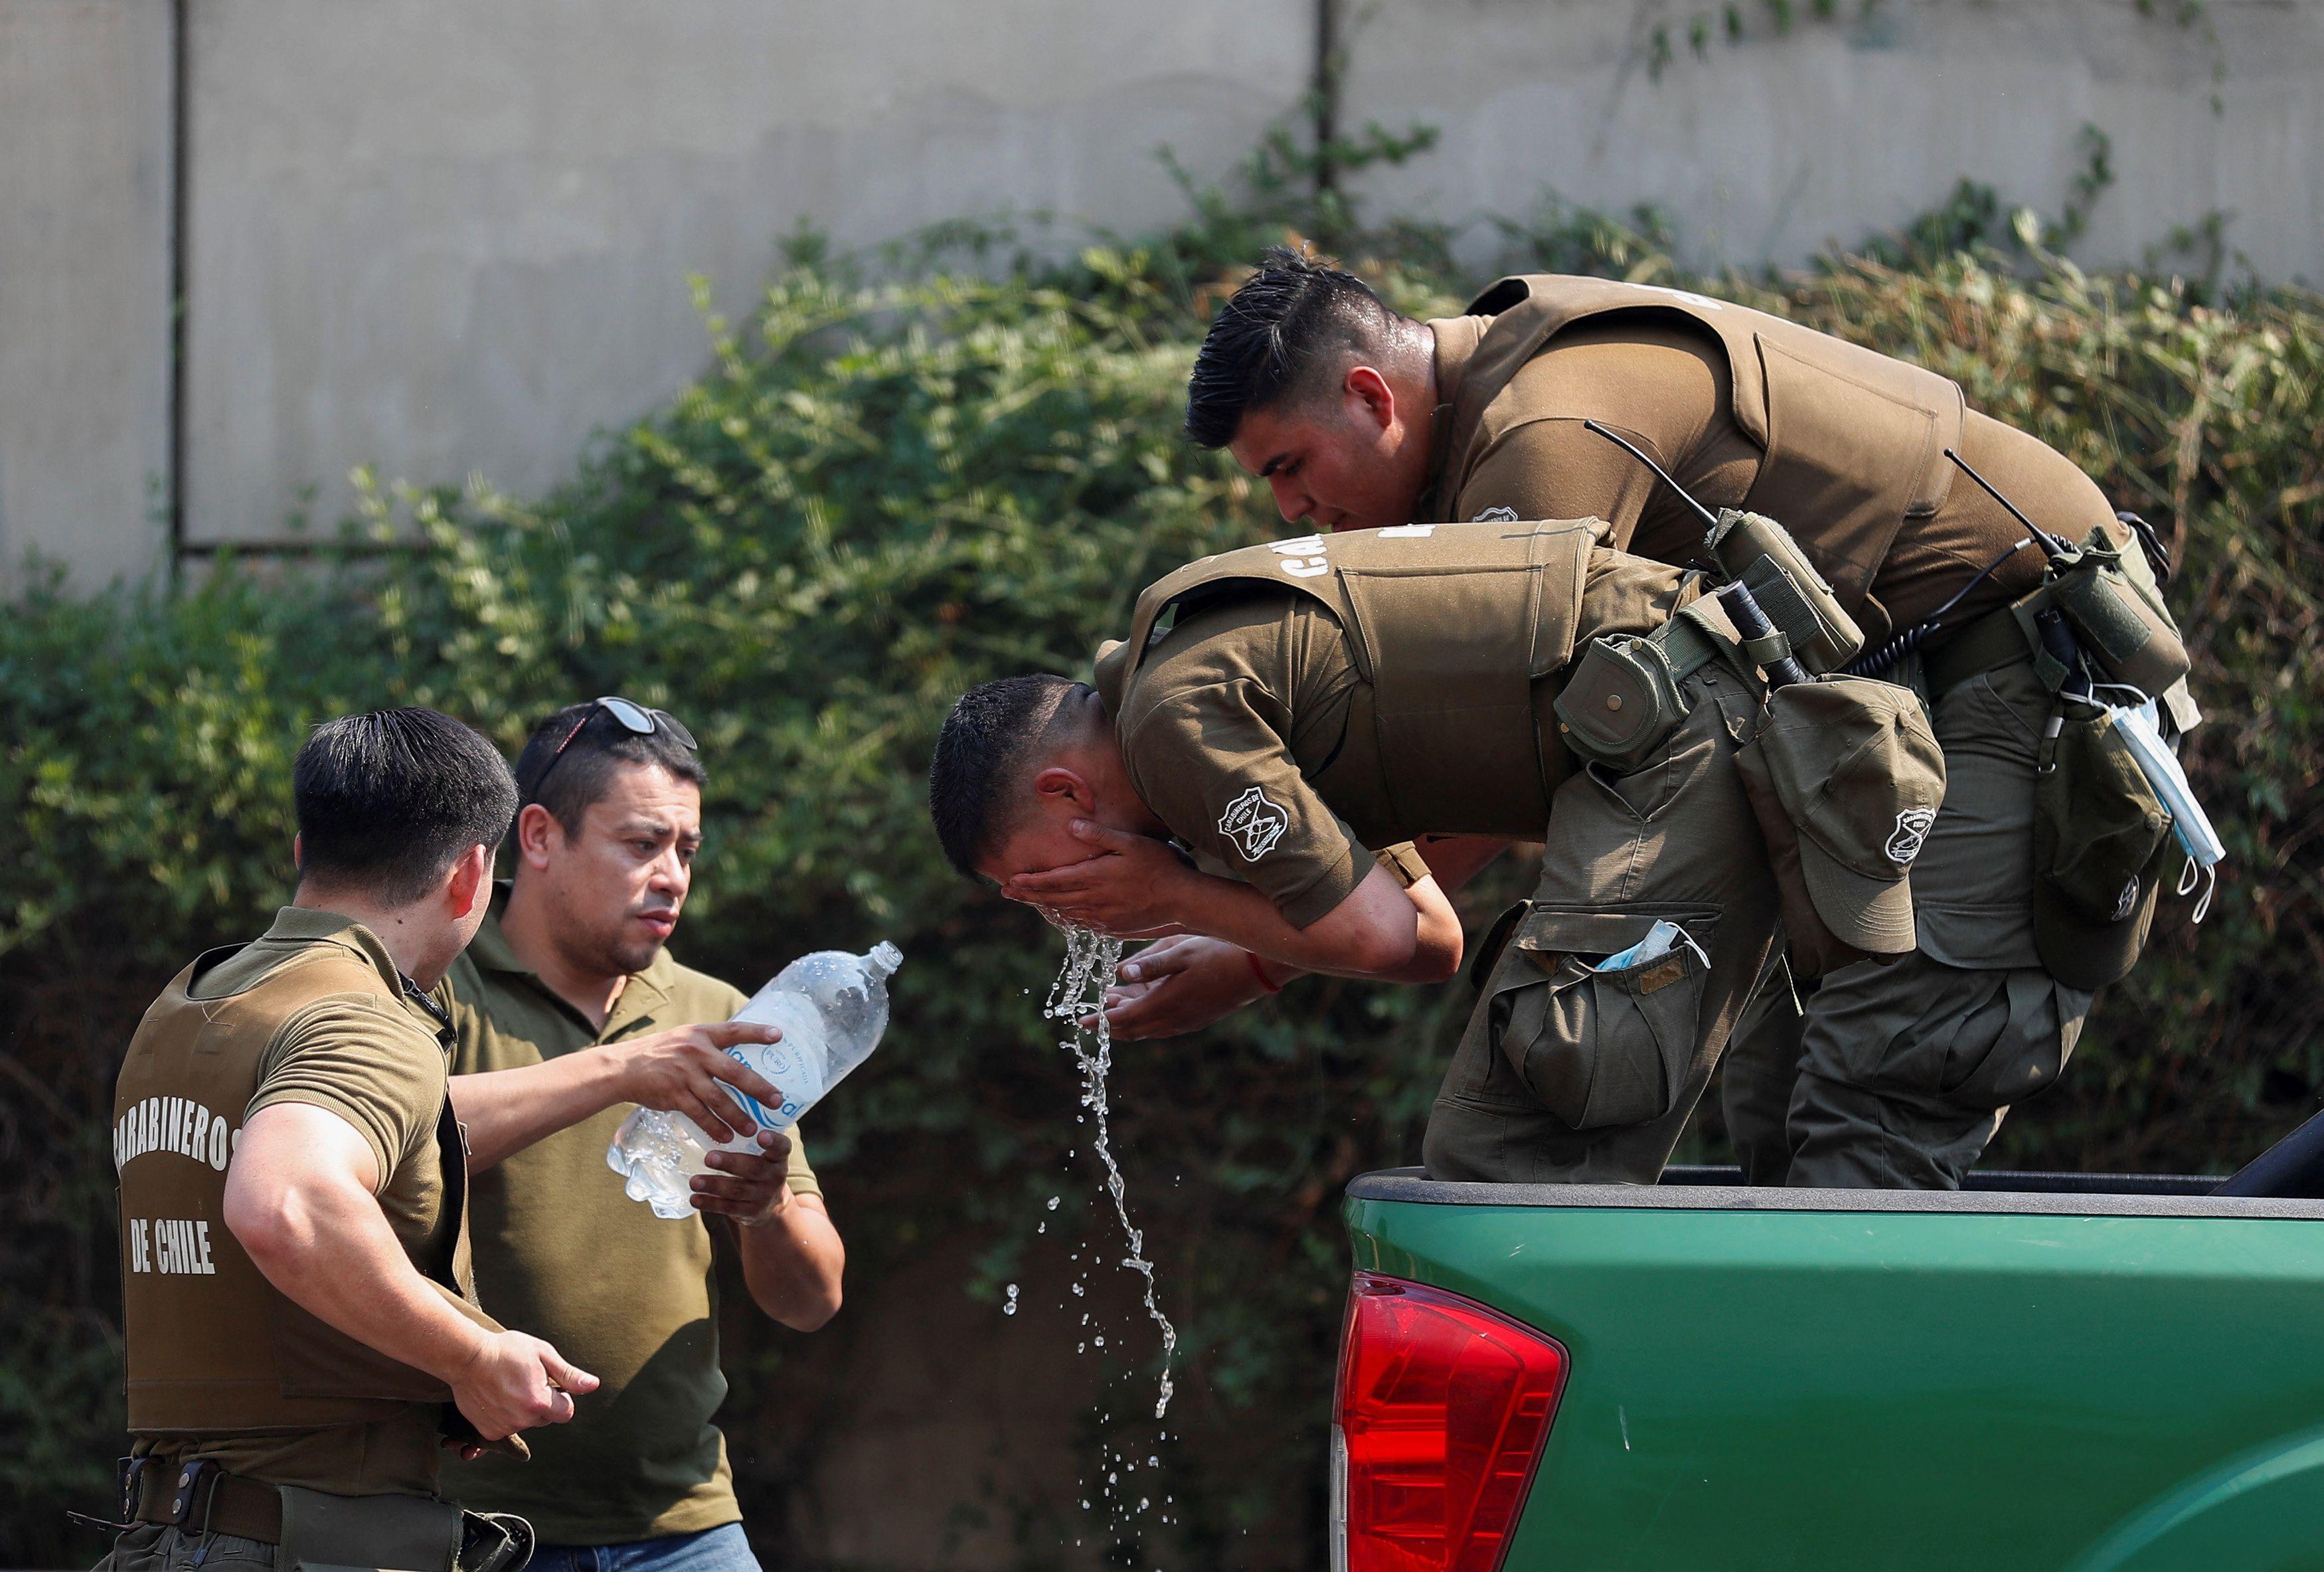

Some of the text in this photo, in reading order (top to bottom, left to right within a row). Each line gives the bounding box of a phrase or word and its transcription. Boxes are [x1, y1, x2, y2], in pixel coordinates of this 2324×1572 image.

[1224, 798, 1253, 831] CARABINEROS
[1236, 808, 1252, 824] CHILE
[766, 1049, 786, 1070] PURO
[130, 1219, 216, 1274] DE CHILE
